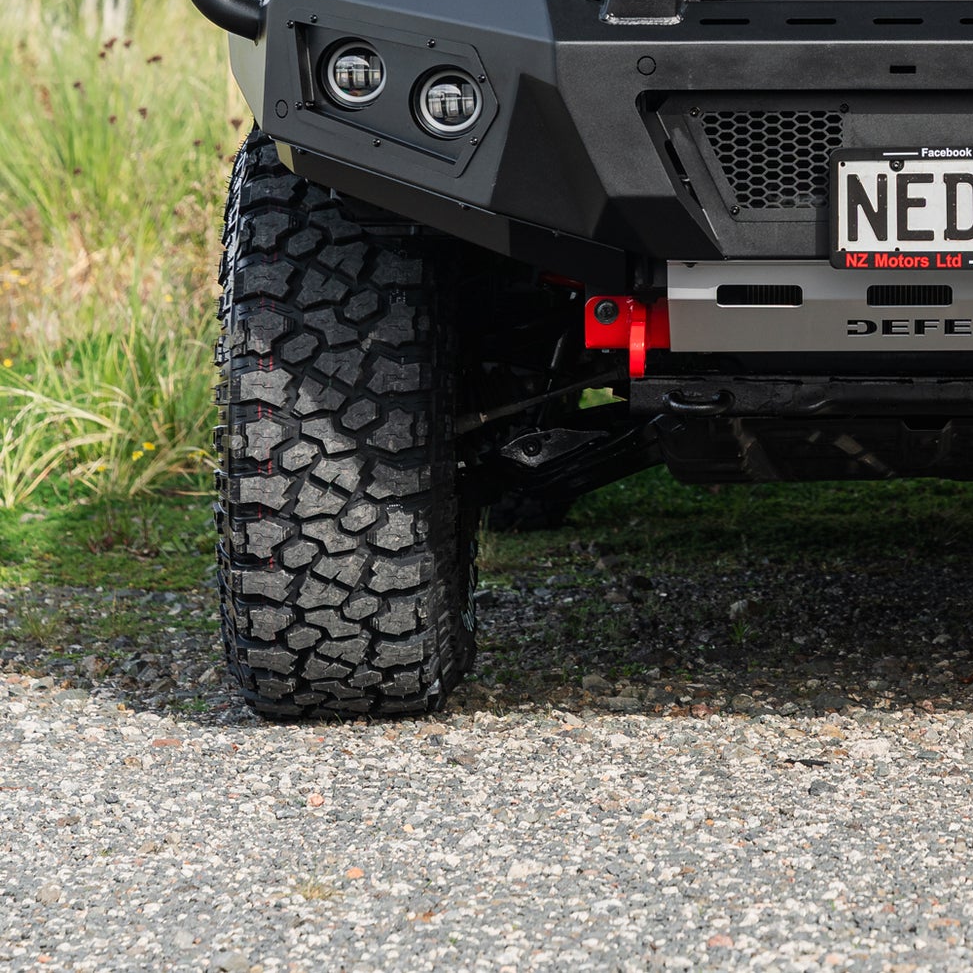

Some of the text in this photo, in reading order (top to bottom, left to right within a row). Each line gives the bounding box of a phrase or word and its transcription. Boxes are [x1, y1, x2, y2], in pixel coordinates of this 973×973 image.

[921, 147, 972, 158] Facebook
[846, 253, 868, 268] NZ
[874, 253, 930, 268] Motors
[936, 253, 963, 268] Ltd
